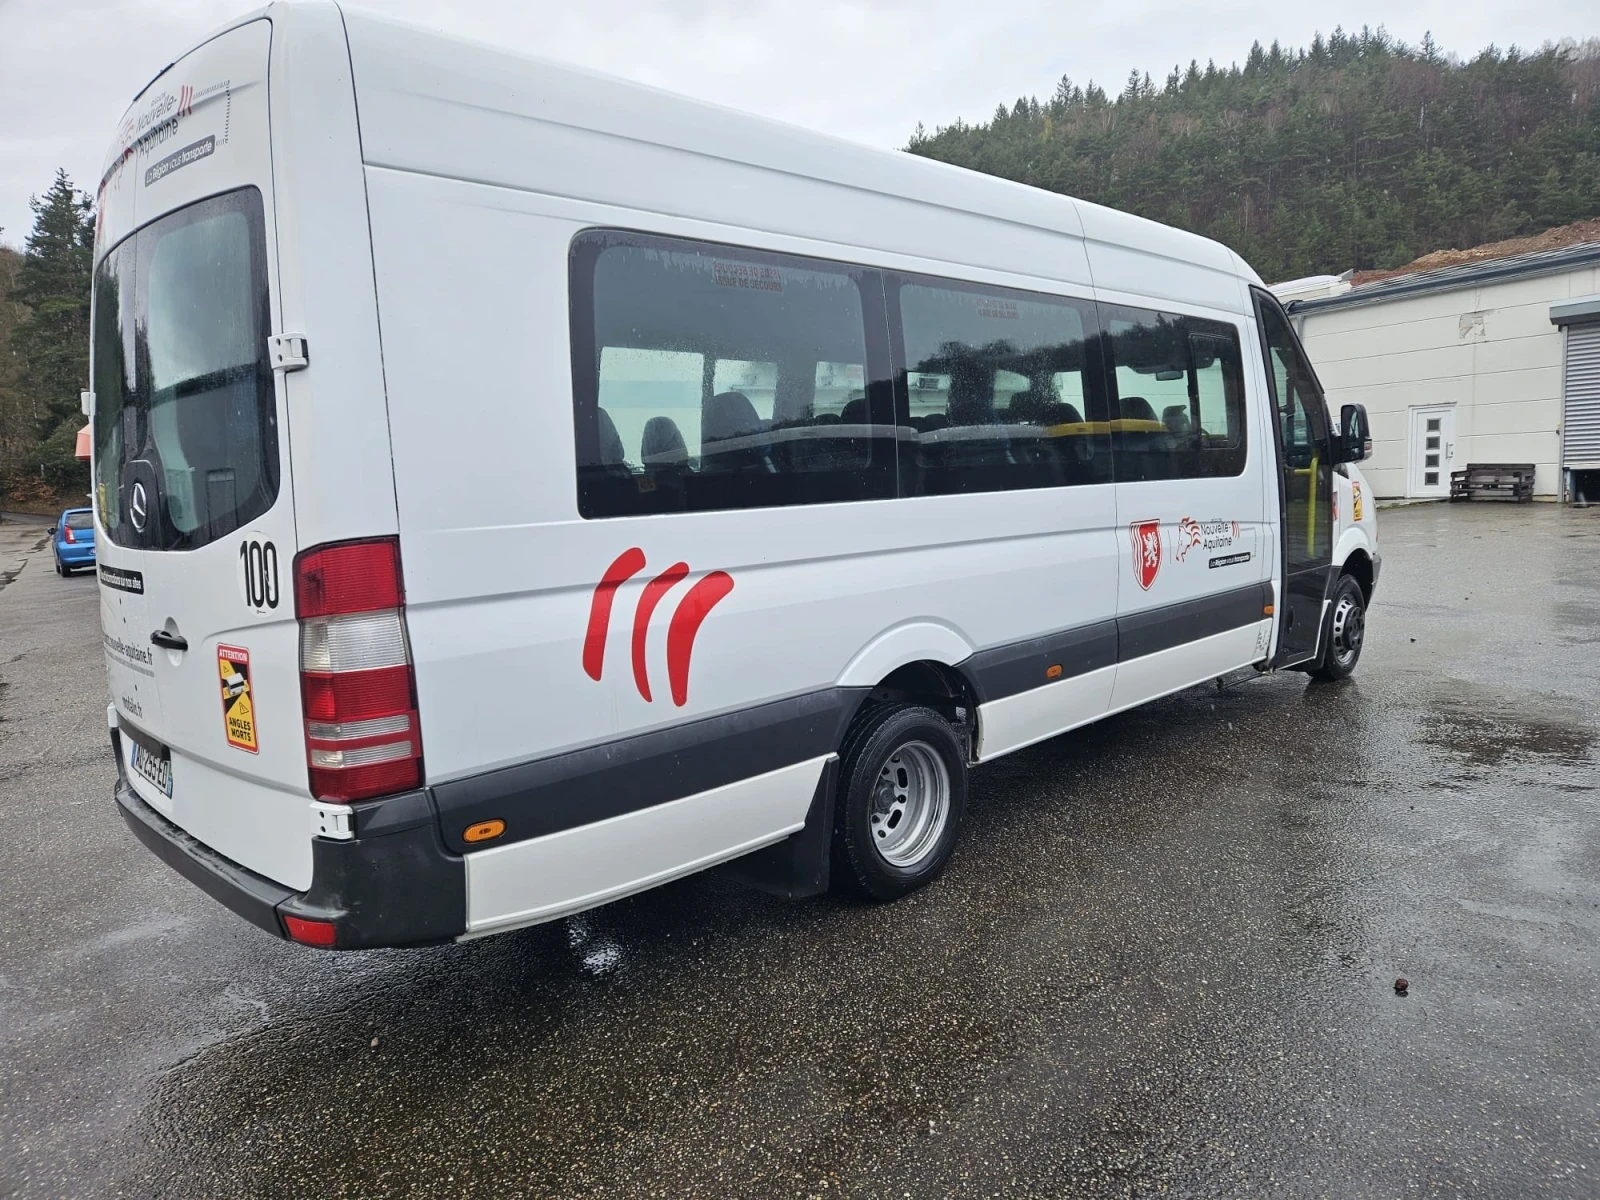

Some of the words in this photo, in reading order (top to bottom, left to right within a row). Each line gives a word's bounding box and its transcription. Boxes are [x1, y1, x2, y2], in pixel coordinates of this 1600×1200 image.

[181, 140, 213, 160] transporte
[1203, 535, 1232, 553] Aquitaine
[240, 540, 280, 610] 100
[219, 649, 248, 663] ATTENTION
[229, 716, 251, 731] ANGLES
[231, 728, 252, 742] MORTS
